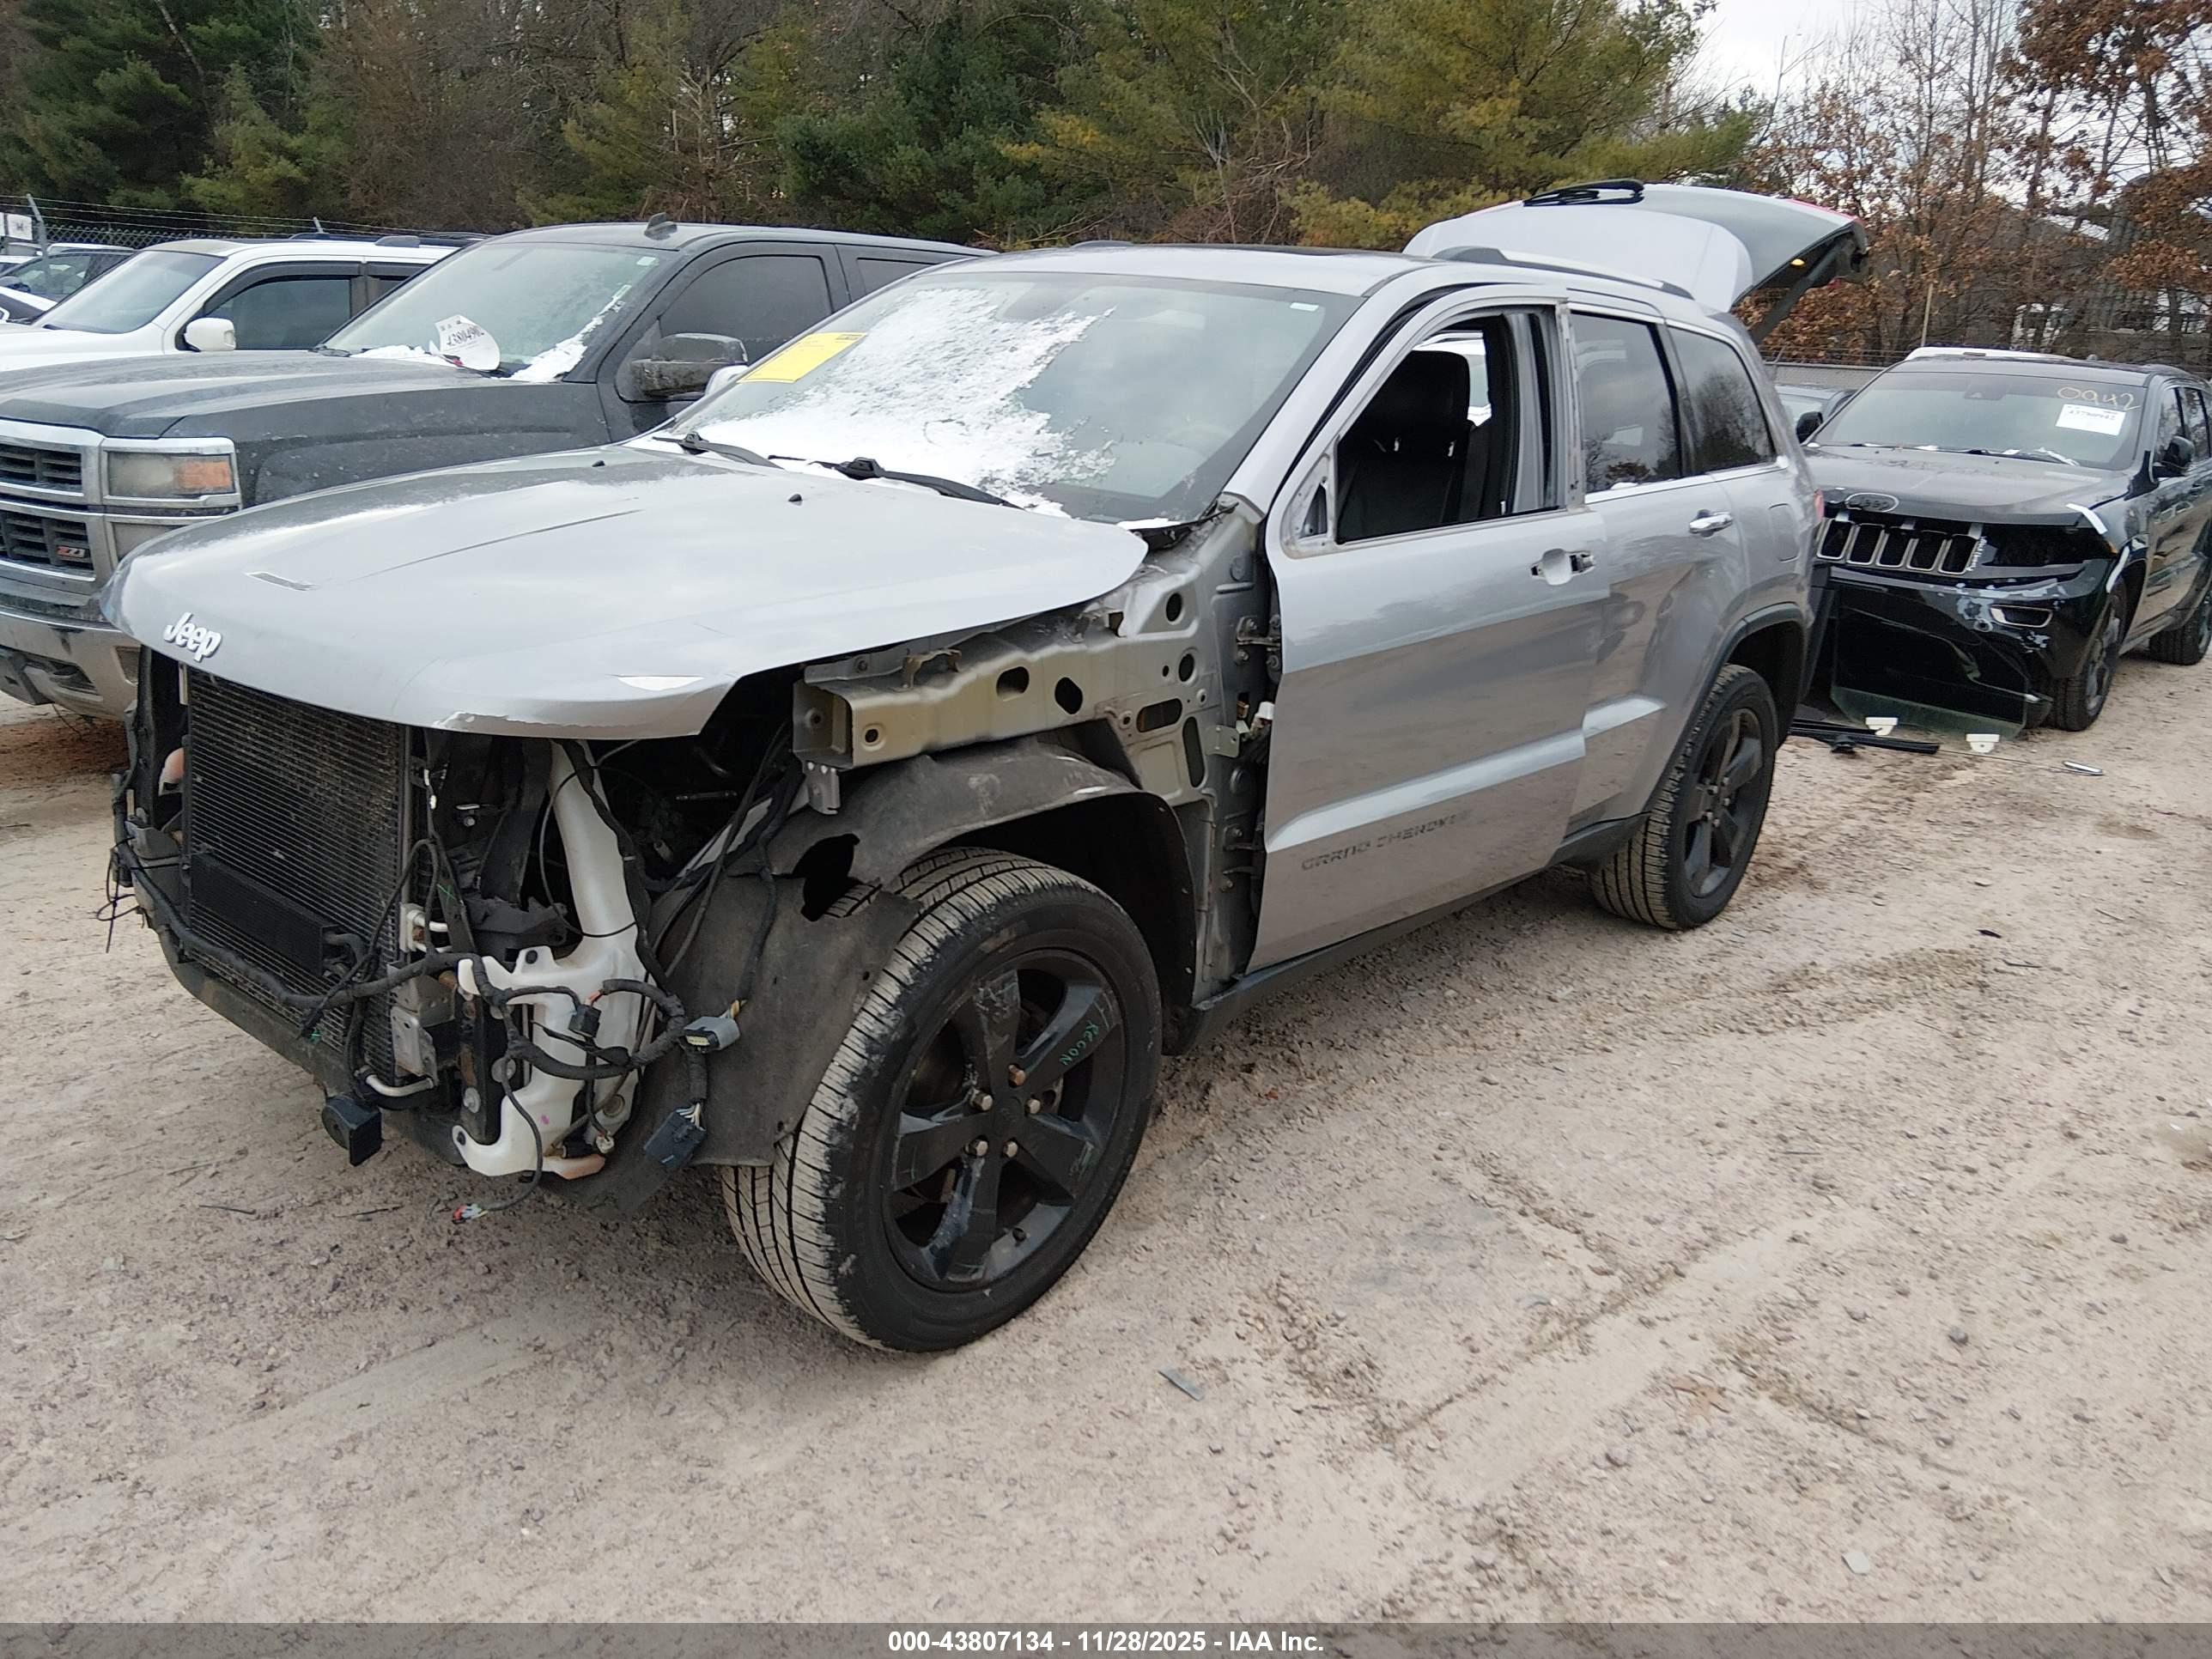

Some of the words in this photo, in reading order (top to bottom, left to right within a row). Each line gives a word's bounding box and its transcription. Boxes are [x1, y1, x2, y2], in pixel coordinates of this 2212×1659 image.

[2057, 386, 2141, 411] 0942
[163, 611, 222, 663] Jeep
[1301, 842, 1370, 871] GRAND
[1376, 811, 1470, 848] CHEROKE
